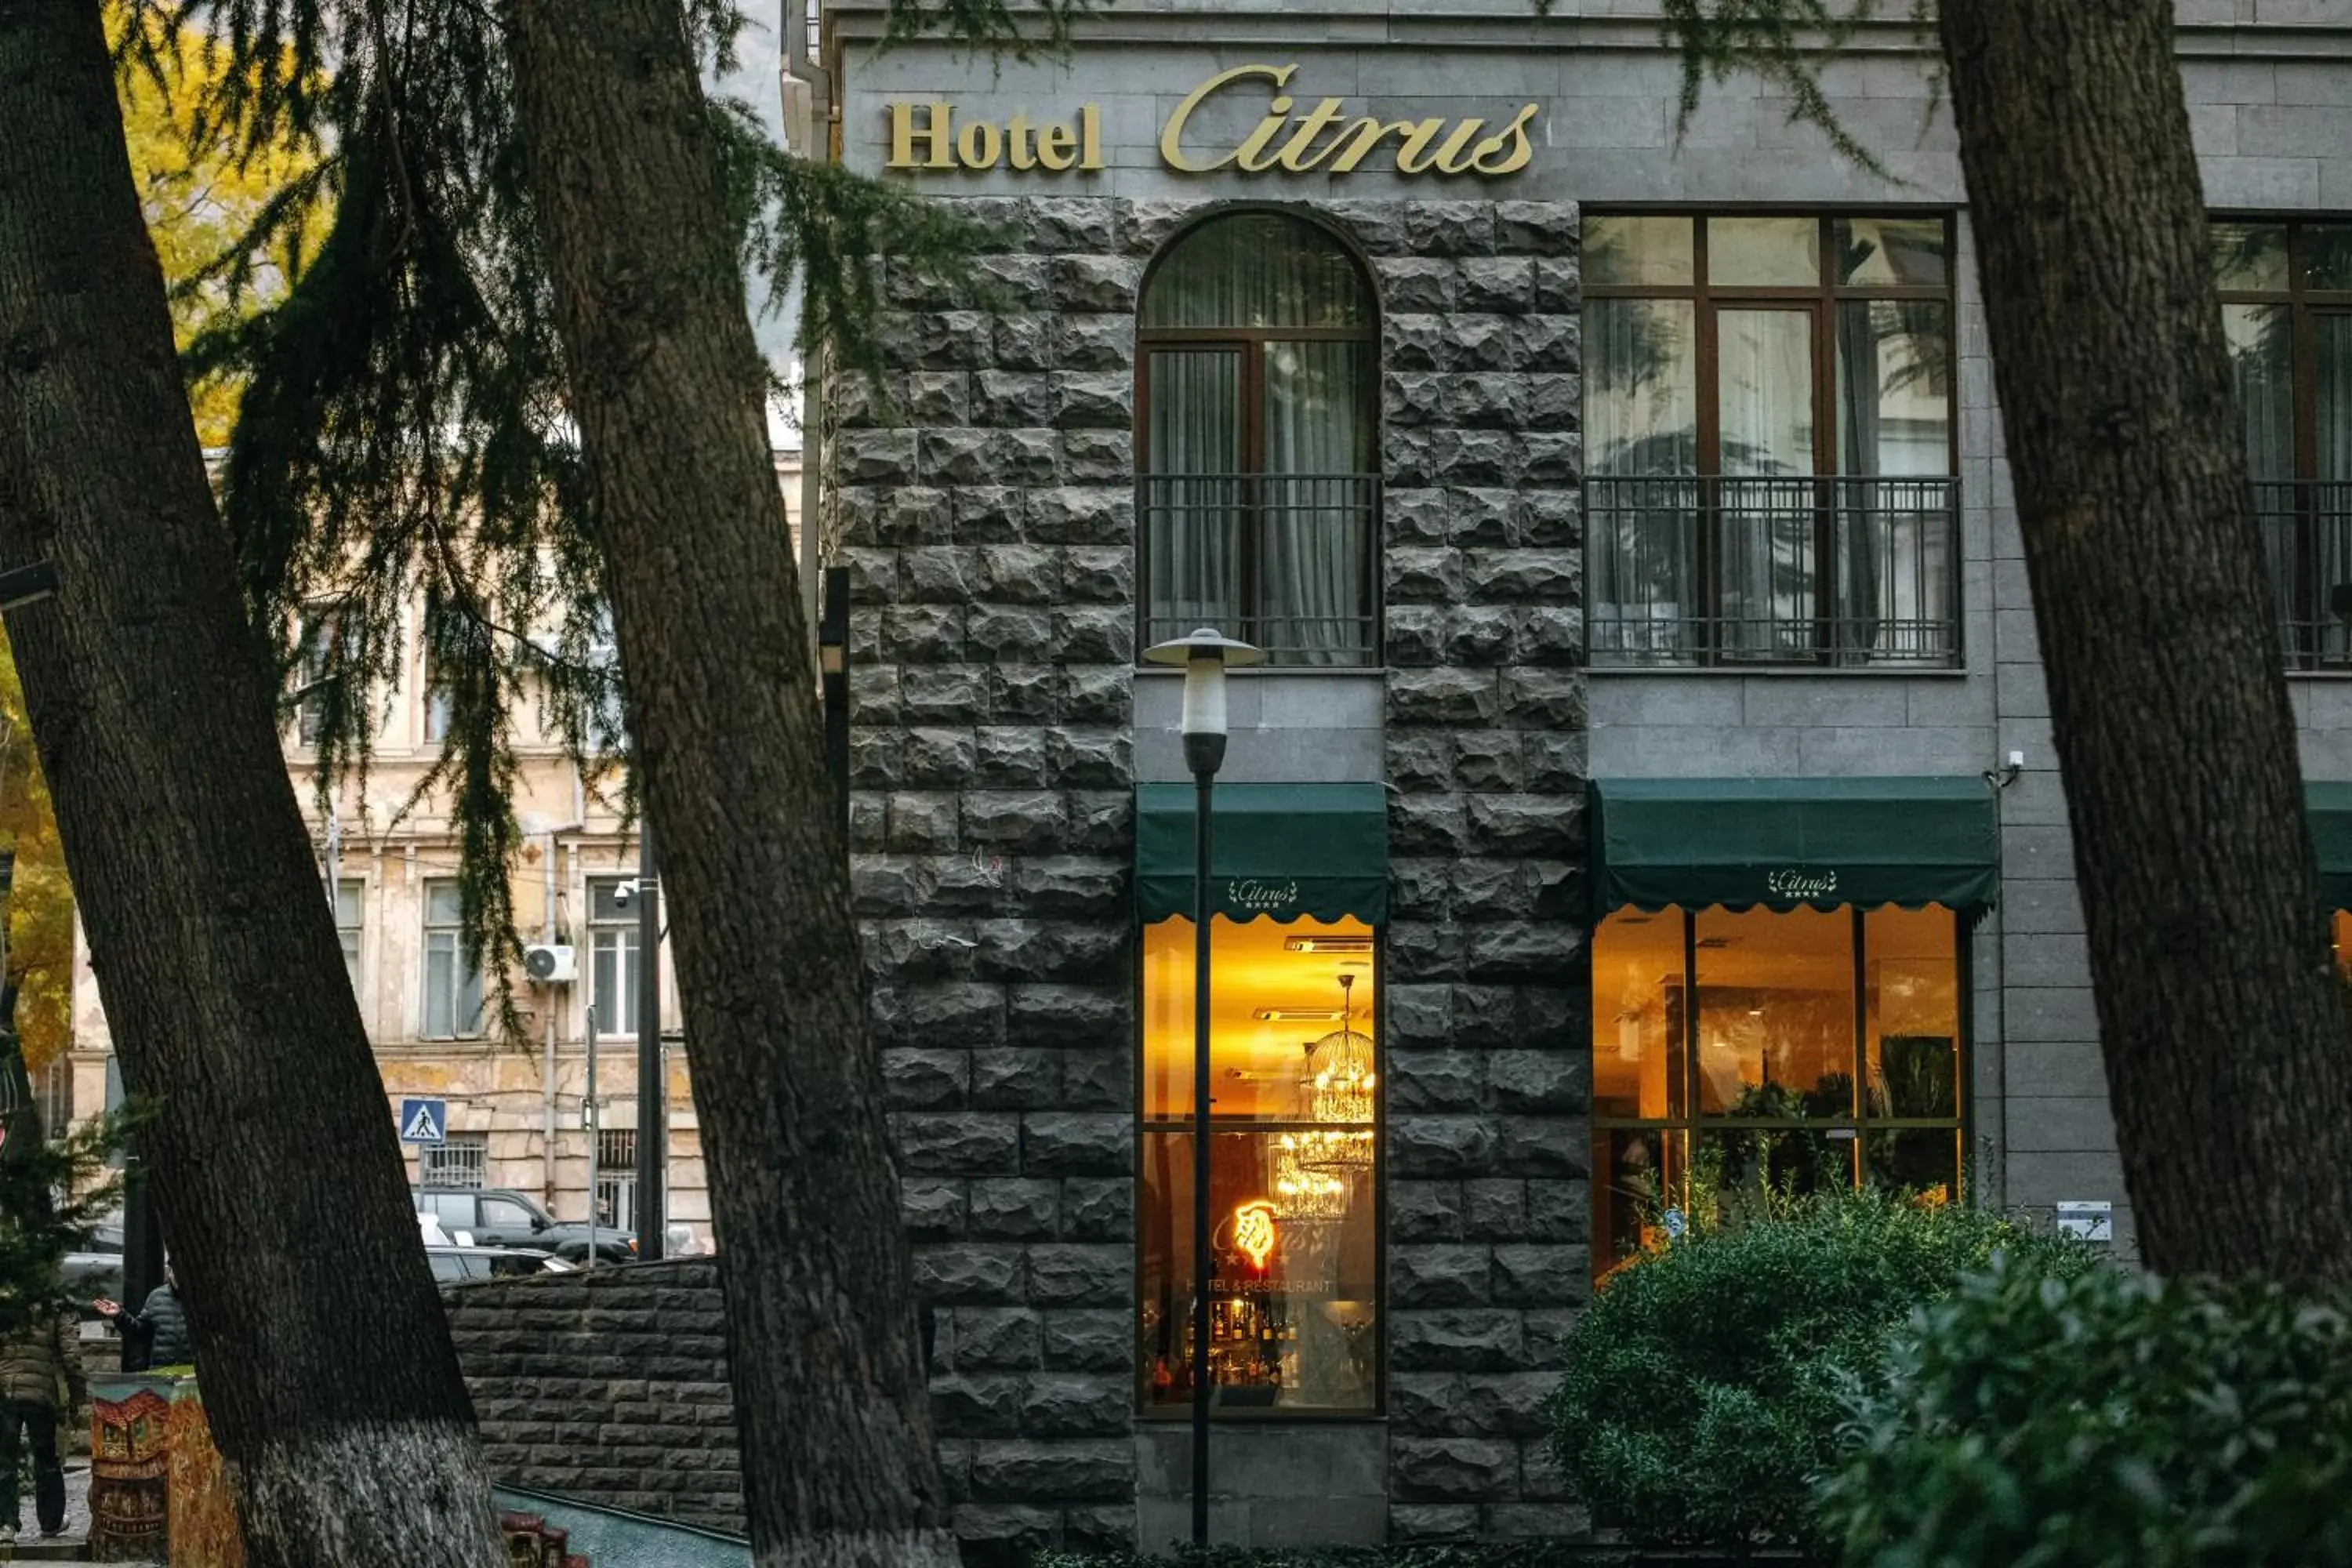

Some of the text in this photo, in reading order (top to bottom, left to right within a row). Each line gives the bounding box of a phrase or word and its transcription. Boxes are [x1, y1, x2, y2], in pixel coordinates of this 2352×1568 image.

[885, 64, 1538, 174] Hotel Citrus
[1239, 879, 1289, 901] Citrus
[1777, 869, 1828, 890] Citrus
[1187, 1279, 1229, 1292] HTEL
[1245, 1279, 1331, 1292] RESTAURANT
